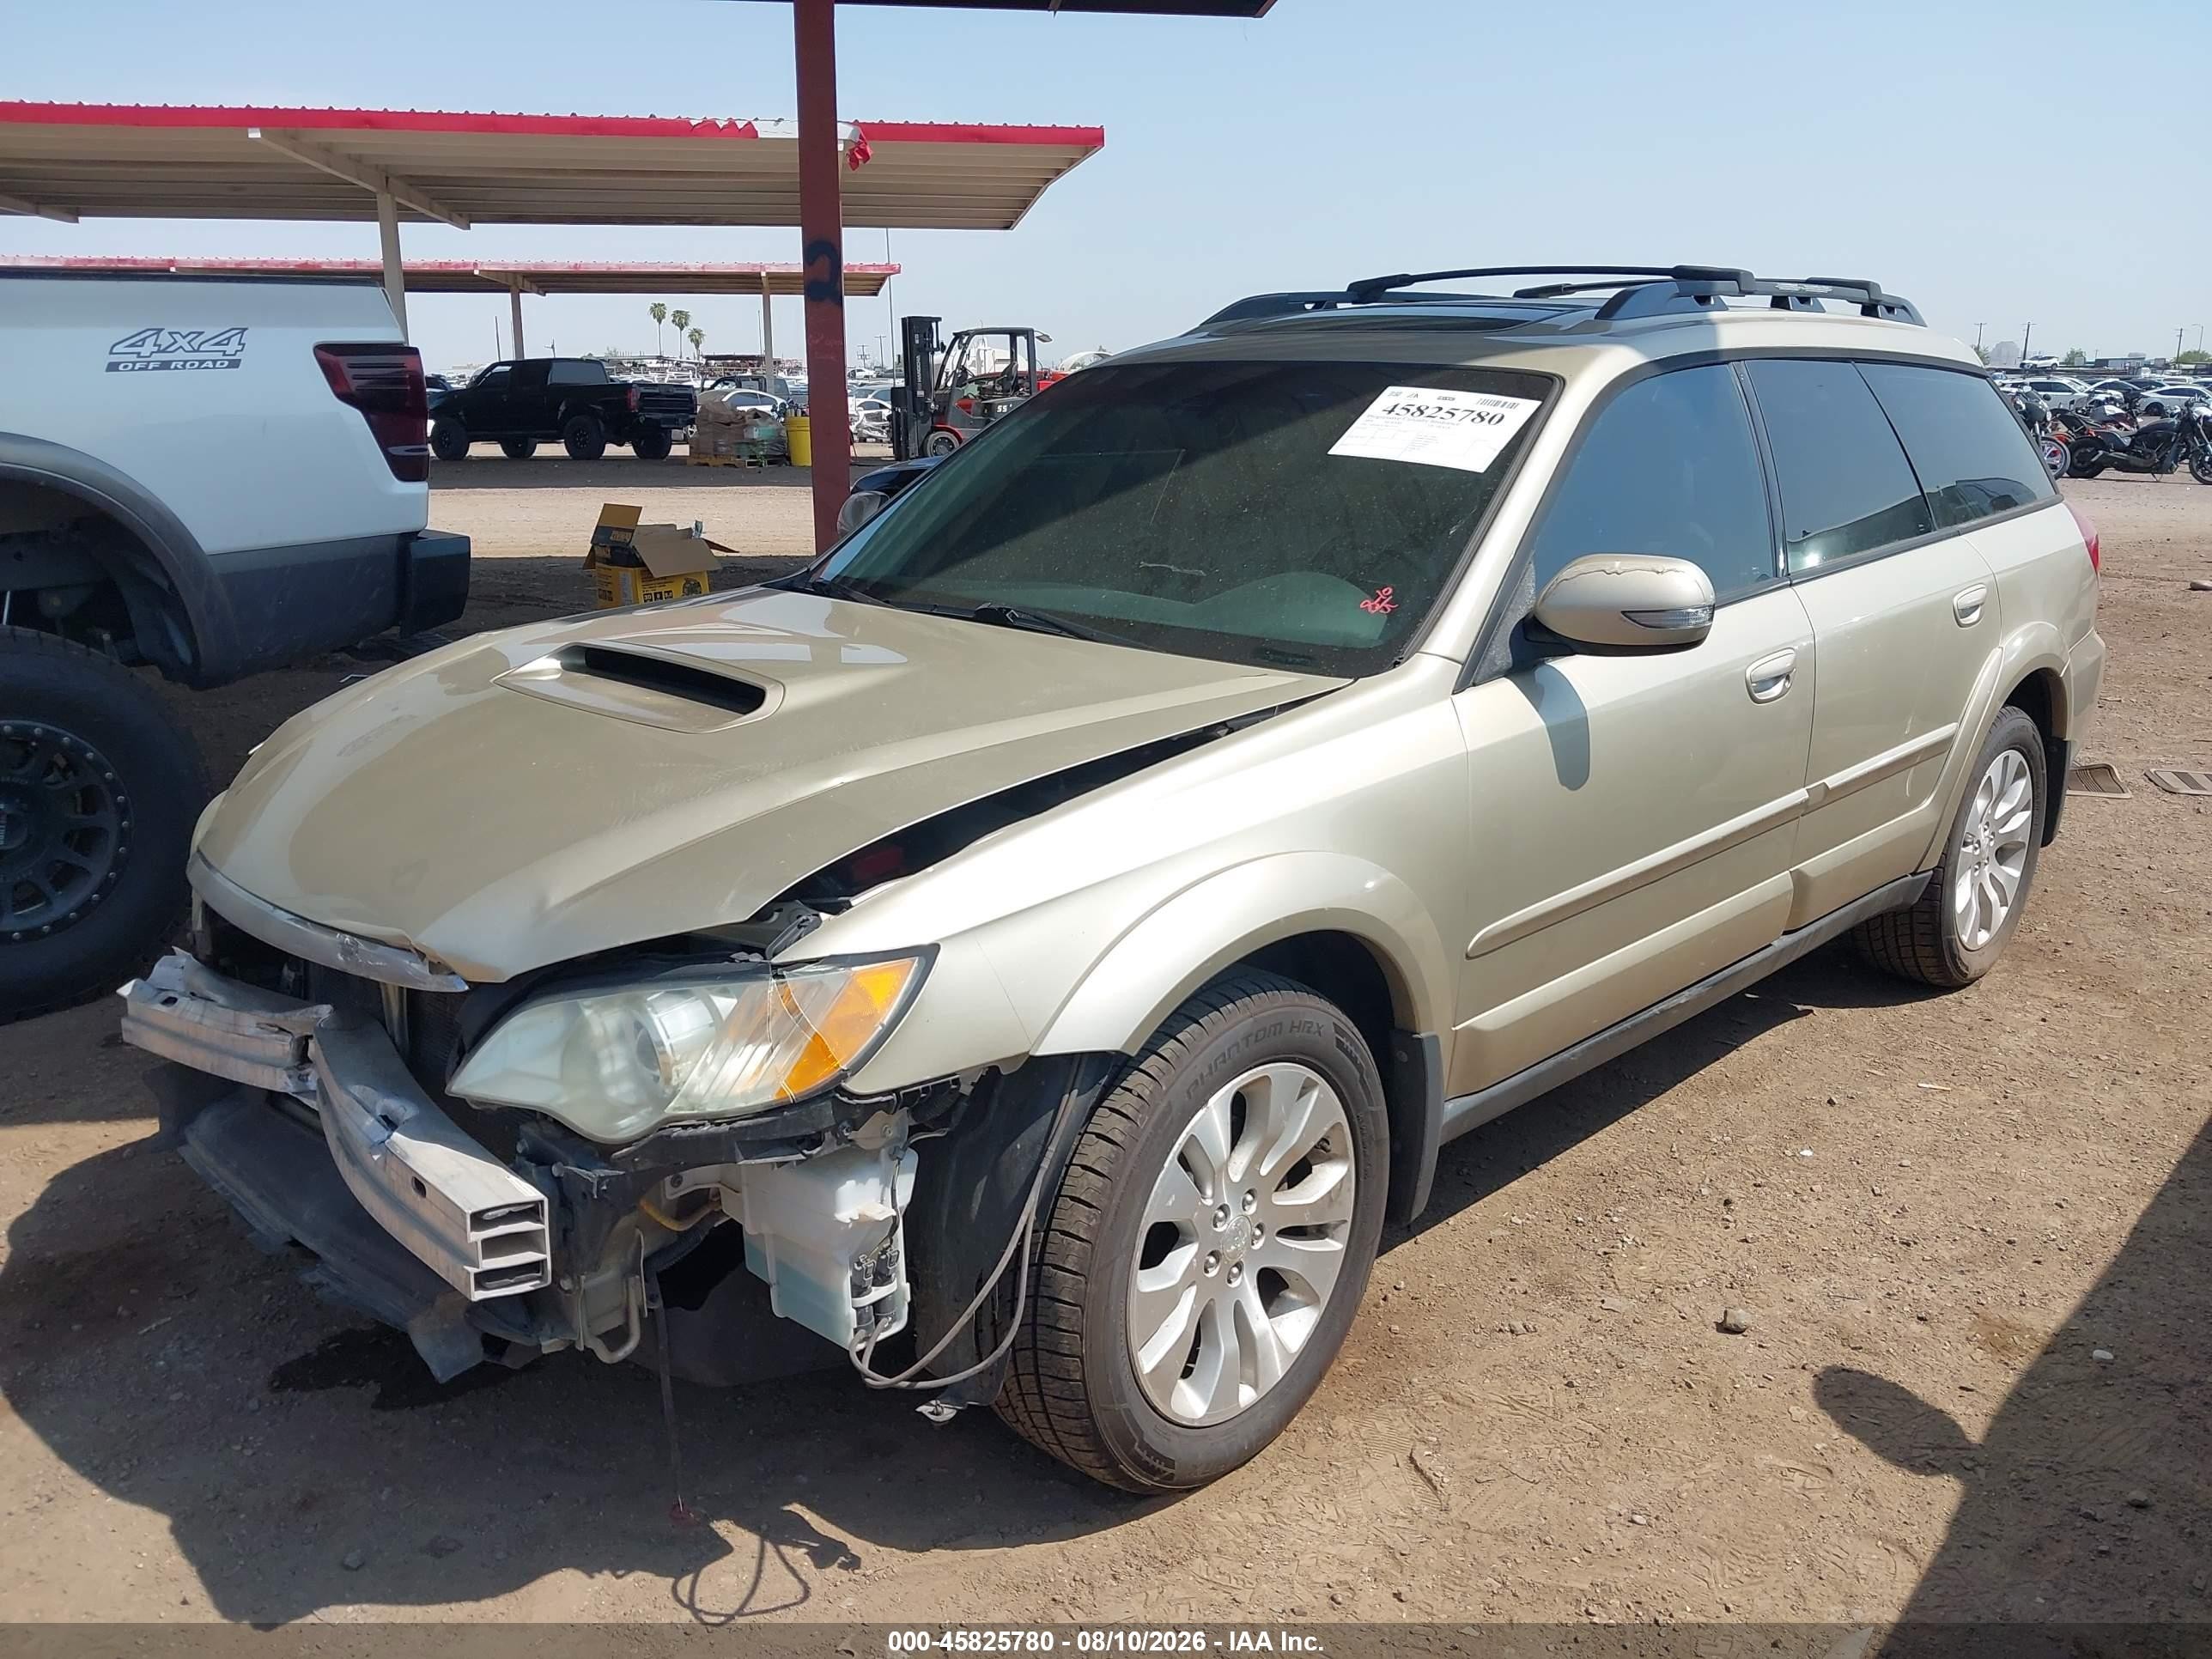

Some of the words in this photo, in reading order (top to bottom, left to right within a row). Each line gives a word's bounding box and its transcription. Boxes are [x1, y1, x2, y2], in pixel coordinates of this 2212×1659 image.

[109, 327, 248, 358] 4x4
[118, 362, 161, 371] OFF
[170, 360, 229, 369] ROAD
[1382, 402, 1505, 426] 45825780
[1290, 1019, 1324, 1037] HRX
